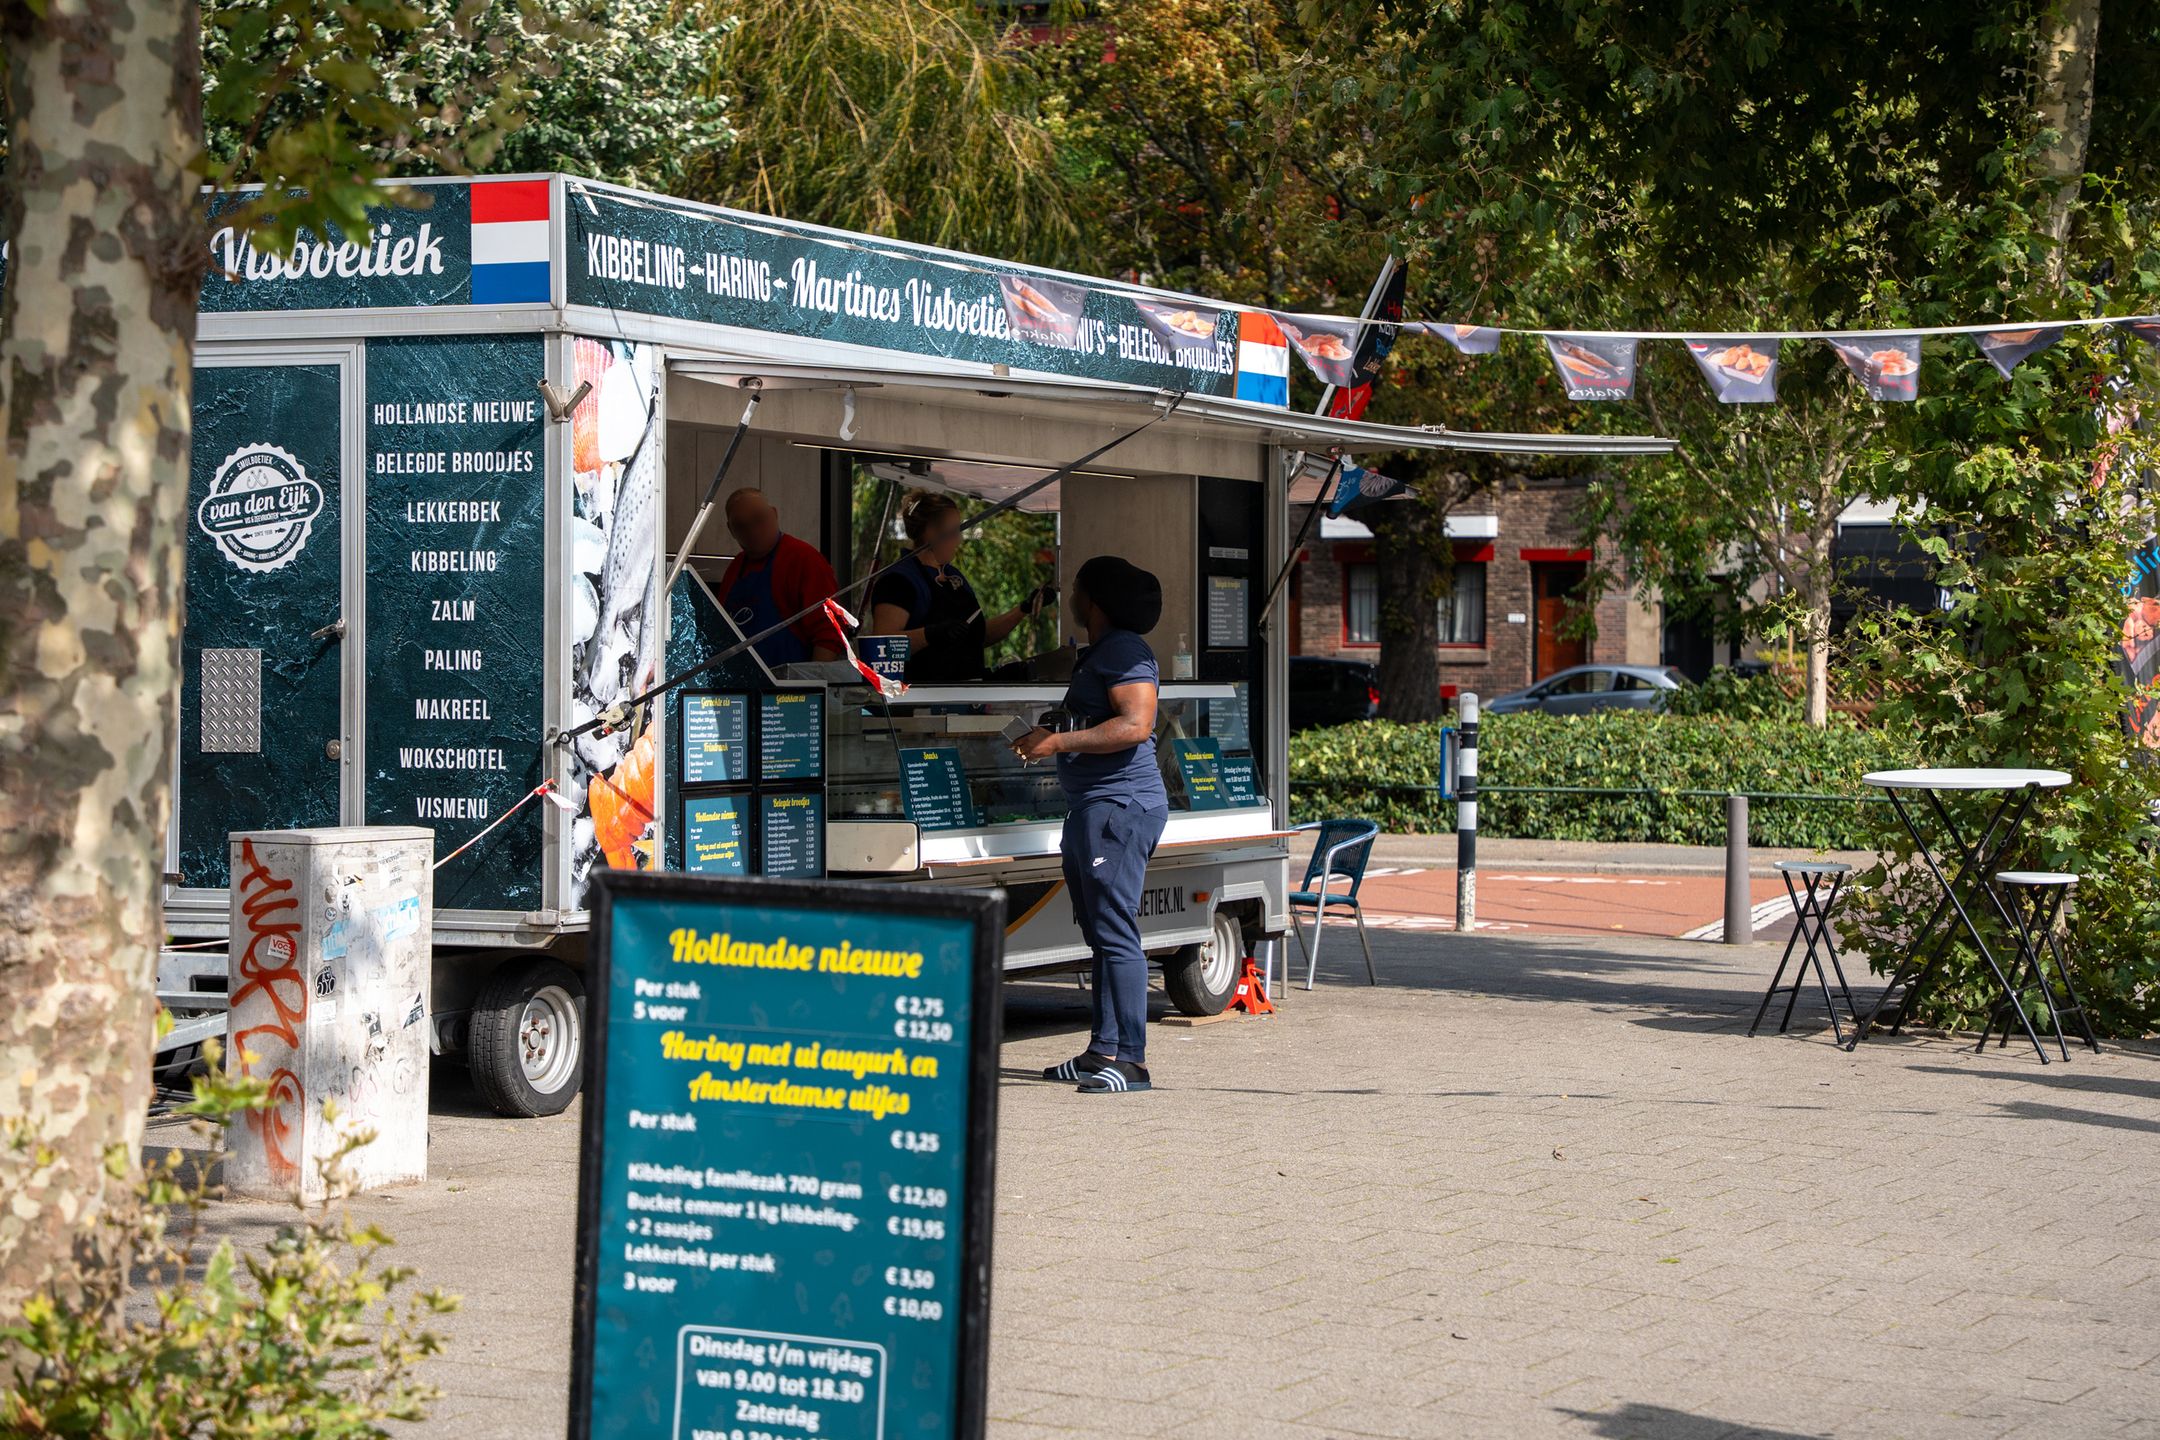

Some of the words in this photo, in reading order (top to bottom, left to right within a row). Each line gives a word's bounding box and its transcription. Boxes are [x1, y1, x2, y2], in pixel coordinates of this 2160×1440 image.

[209, 222, 445, 282] Visboetiek
[587, 232, 686, 289] KIBBELING
[705, 252, 771, 302] HARING
[791, 257, 900, 323] Martines
[905, 277, 1012, 341] Visboetie
[374, 402, 467, 425] HOLLANDSE
[473, 401, 535, 423] NIEUWE
[376, 452, 446, 474] BELEGDE
[452, 451, 533, 473] BROODJES
[209, 501, 241, 520] van
[244, 494, 276, 515] den
[278, 485, 311, 513] Eijk
[407, 501, 501, 523] LEKKERBEK
[411, 551, 497, 572] KIBBELING
[431, 600, 475, 621] ZALM
[425, 649, 482, 670] PALING
[877, 645, 887, 658] I
[415, 699, 491, 720] MAKREEL
[400, 748, 507, 770] WOKSCHOTEL
[416, 797, 488, 819] VISMENU
[1136, 886, 1186, 917] OETIEK.NL
[669, 927, 815, 970] Hollandse
[818, 939, 924, 978] nieuwe
[635, 978, 664, 997] Per
[665, 981, 701, 999] stuk
[633, 1001, 646, 1019] 5
[648, 1005, 687, 1021] voor
[895, 995, 907, 1014] €
[909, 997, 944, 1018] 2,75
[894, 1018, 907, 1037] €
[909, 1020, 953, 1042] 12,50
[660, 1030, 745, 1071] Haring
[747, 1041, 792, 1066] met
[794, 1042, 821, 1068] ui
[821, 1048, 908, 1080] augurk
[910, 1055, 938, 1078] en
[688, 1071, 847, 1109] Amsterdamse
[849, 1084, 910, 1120] uitjes
[629, 1109, 659, 1129] Per
[660, 1112, 697, 1131] stuk
[890, 1130, 903, 1149] €
[904, 1131, 940, 1153] 3,25
[628, 1162, 703, 1189] Kibbeling
[705, 1167, 786, 1192] familiezak
[788, 1174, 819, 1195] 700
[820, 1181, 863, 1200] gram
[627, 1191, 682, 1213] Bucket
[684, 1200, 743, 1217] emmer
[745, 1200, 756, 1219] 1
[759, 1201, 779, 1224] kg
[888, 1184, 901, 1203] €
[903, 1186, 947, 1208] 12,50
[640, 1217, 652, 1236] 2
[654, 1220, 713, 1243] sausjes
[887, 1216, 900, 1235] €
[902, 1217, 945, 1240] 19,95
[624, 1242, 708, 1267] Lekkerbek
[709, 1252, 739, 1271] per
[740, 1253, 776, 1273] stuk
[623, 1272, 636, 1291] 3
[637, 1276, 677, 1293] voor
[885, 1266, 898, 1286] €
[899, 1267, 935, 1290] 3,50
[884, 1296, 897, 1315] €
[898, 1297, 943, 1321] 10,00
[689, 1335, 765, 1366] Dinsdag
[768, 1341, 805, 1367] t/m
[808, 1347, 874, 1378] vrijdag
[696, 1369, 732, 1388] van
[734, 1369, 776, 1393] 9.00
[778, 1374, 808, 1397] tot
[811, 1378, 864, 1403] 18.30
[736, 1399, 820, 1433] Zaterdag
